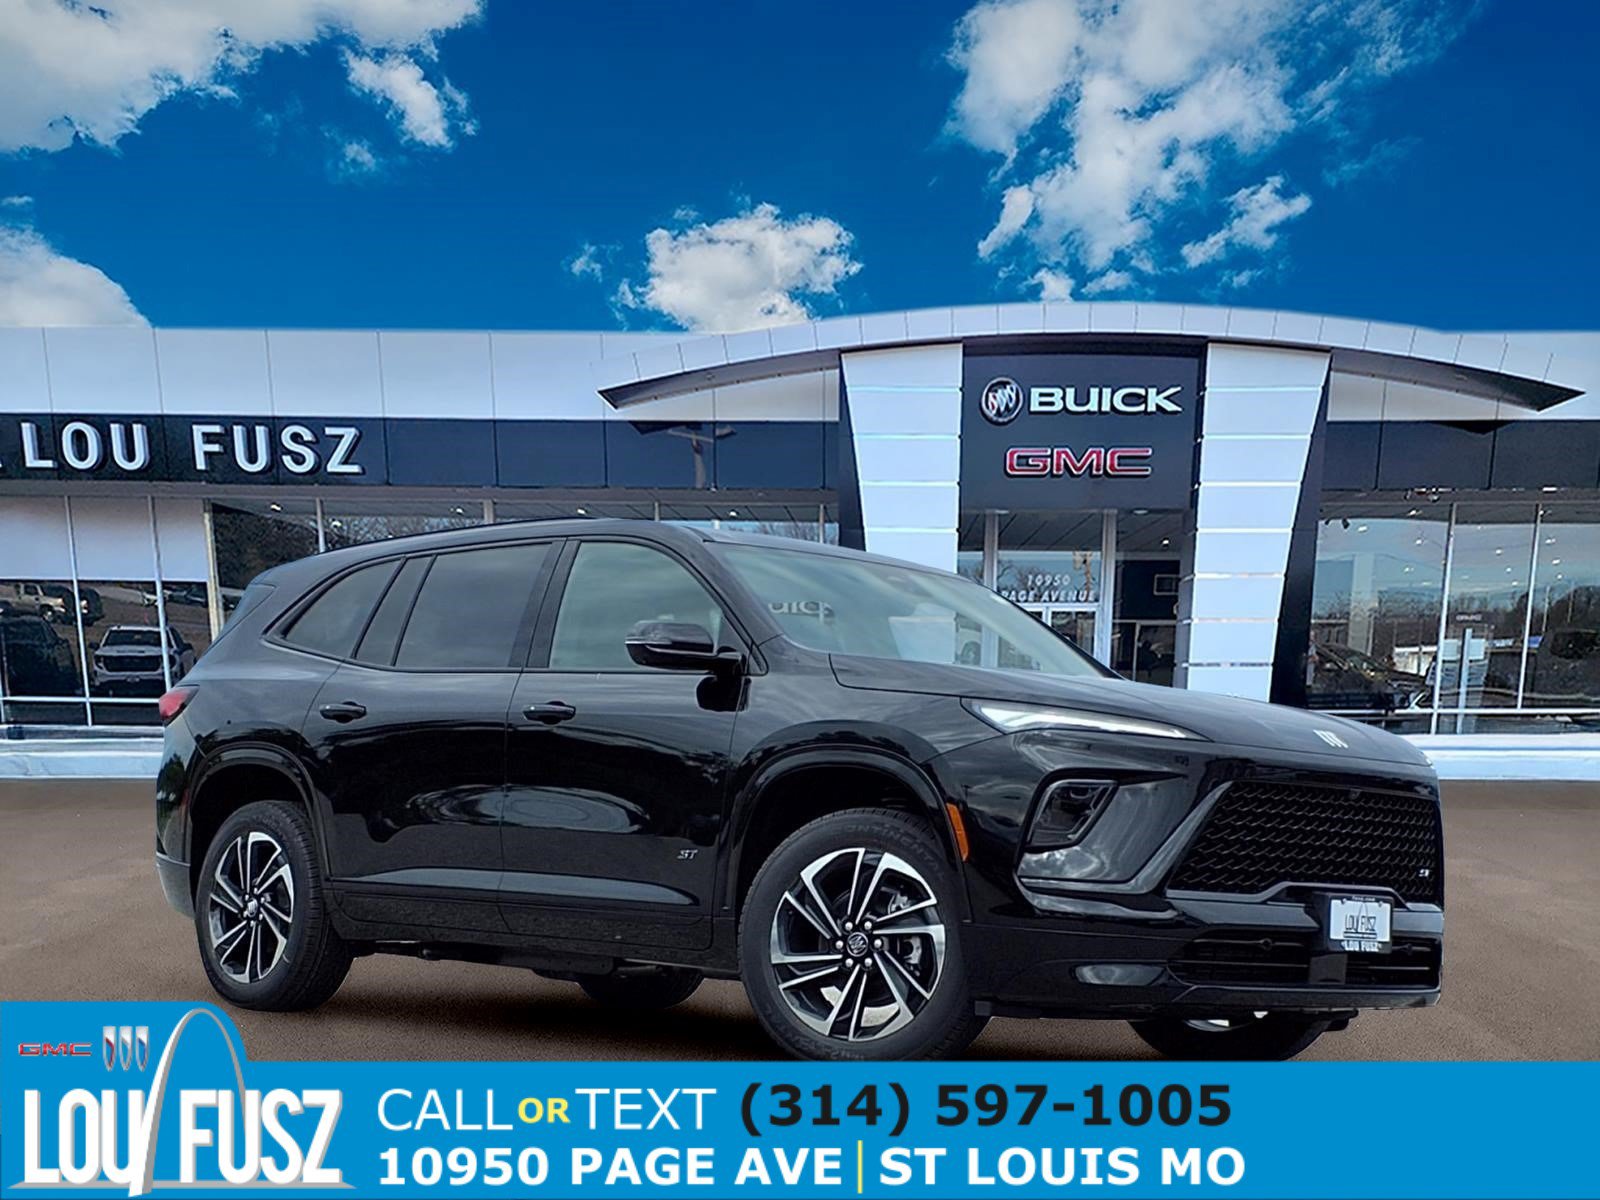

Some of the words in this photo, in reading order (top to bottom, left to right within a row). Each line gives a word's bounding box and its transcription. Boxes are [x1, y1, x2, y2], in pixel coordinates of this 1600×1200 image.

[1029, 386, 1182, 412] BUICK
[20, 421, 150, 471] LOU
[191, 424, 363, 475] FUSZ
[1006, 447, 1153, 476] GMC
[1027, 574, 1071, 587] 10950
[1041, 589, 1096, 602] AVENUE
[677, 848, 699, 860] ST
